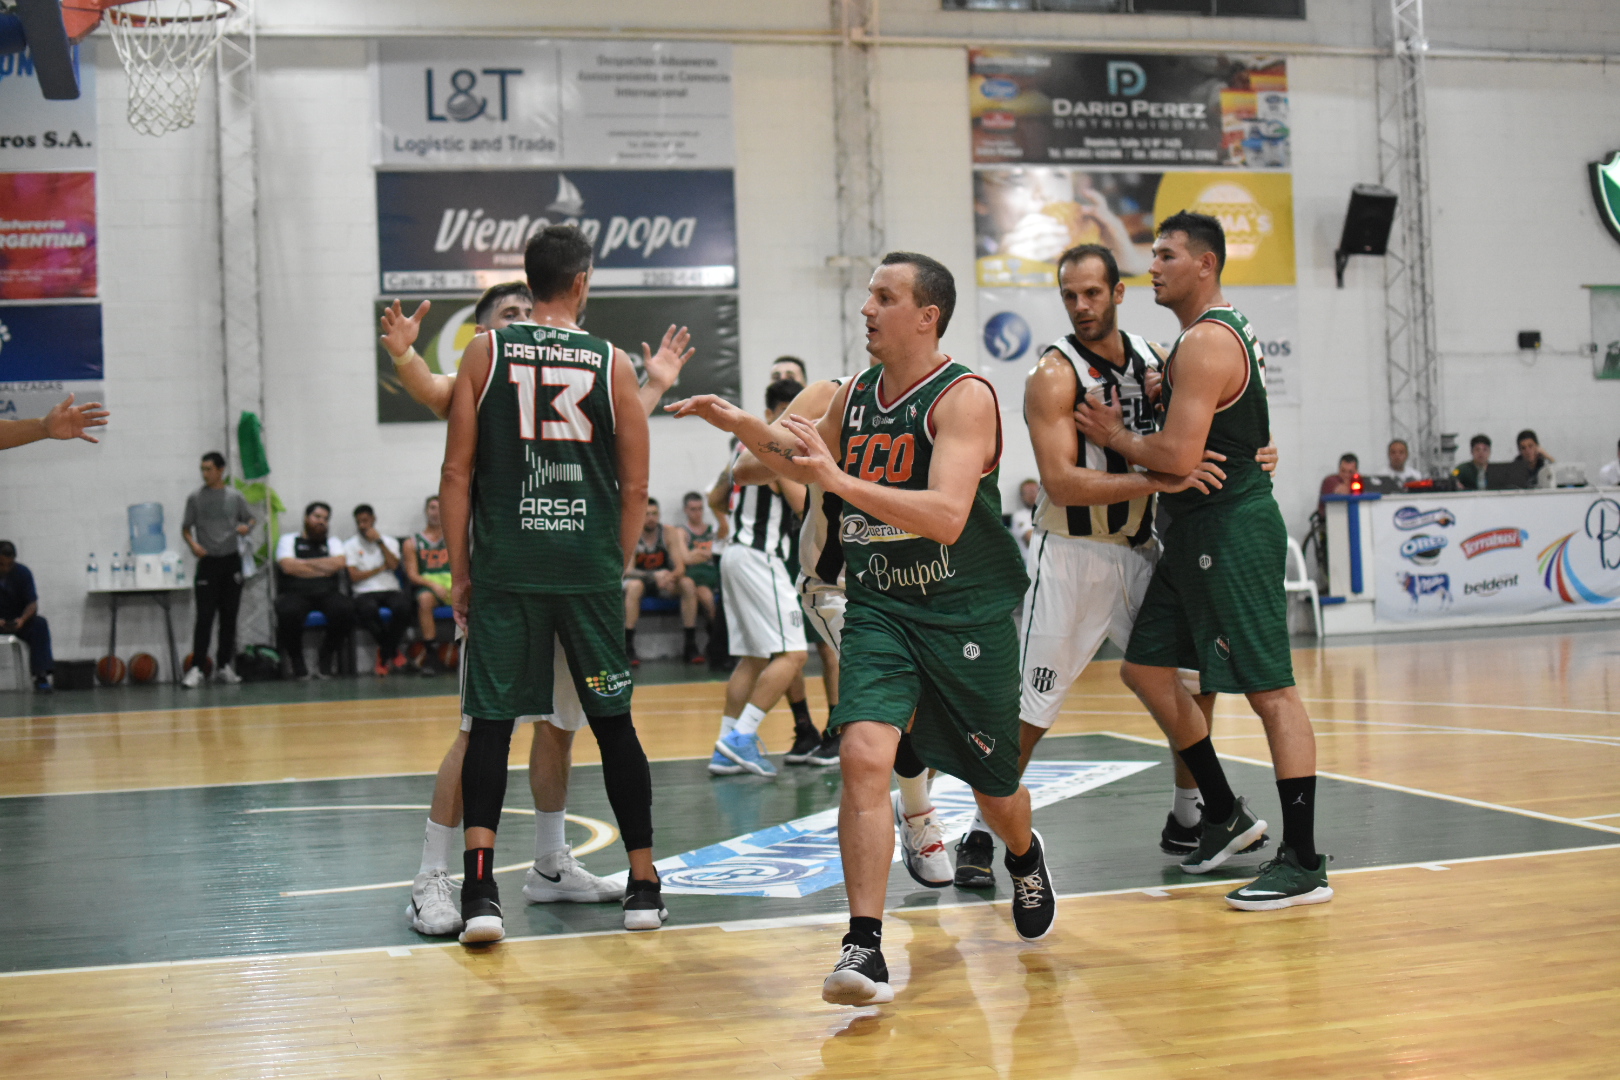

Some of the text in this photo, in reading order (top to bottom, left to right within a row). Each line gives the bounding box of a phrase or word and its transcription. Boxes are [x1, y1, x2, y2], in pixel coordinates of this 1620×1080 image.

[425, 67, 524, 122] L&T
[1052, 98, 1208, 119] DARIO PEREZ
[43, 131, 92, 148] S.A.
[394, 135, 556, 156] Logistic and Trade
[600, 216, 697, 259] popa
[504, 342, 603, 369] CASTIÑEIRA
[508, 363, 597, 443] 13
[849, 405, 866, 431] 4
[844, 432, 915, 483] FCO
[519, 498, 587, 516] ARSA
[521, 518, 585, 531] REMAN
[1464, 574, 1519, 596] beldent
